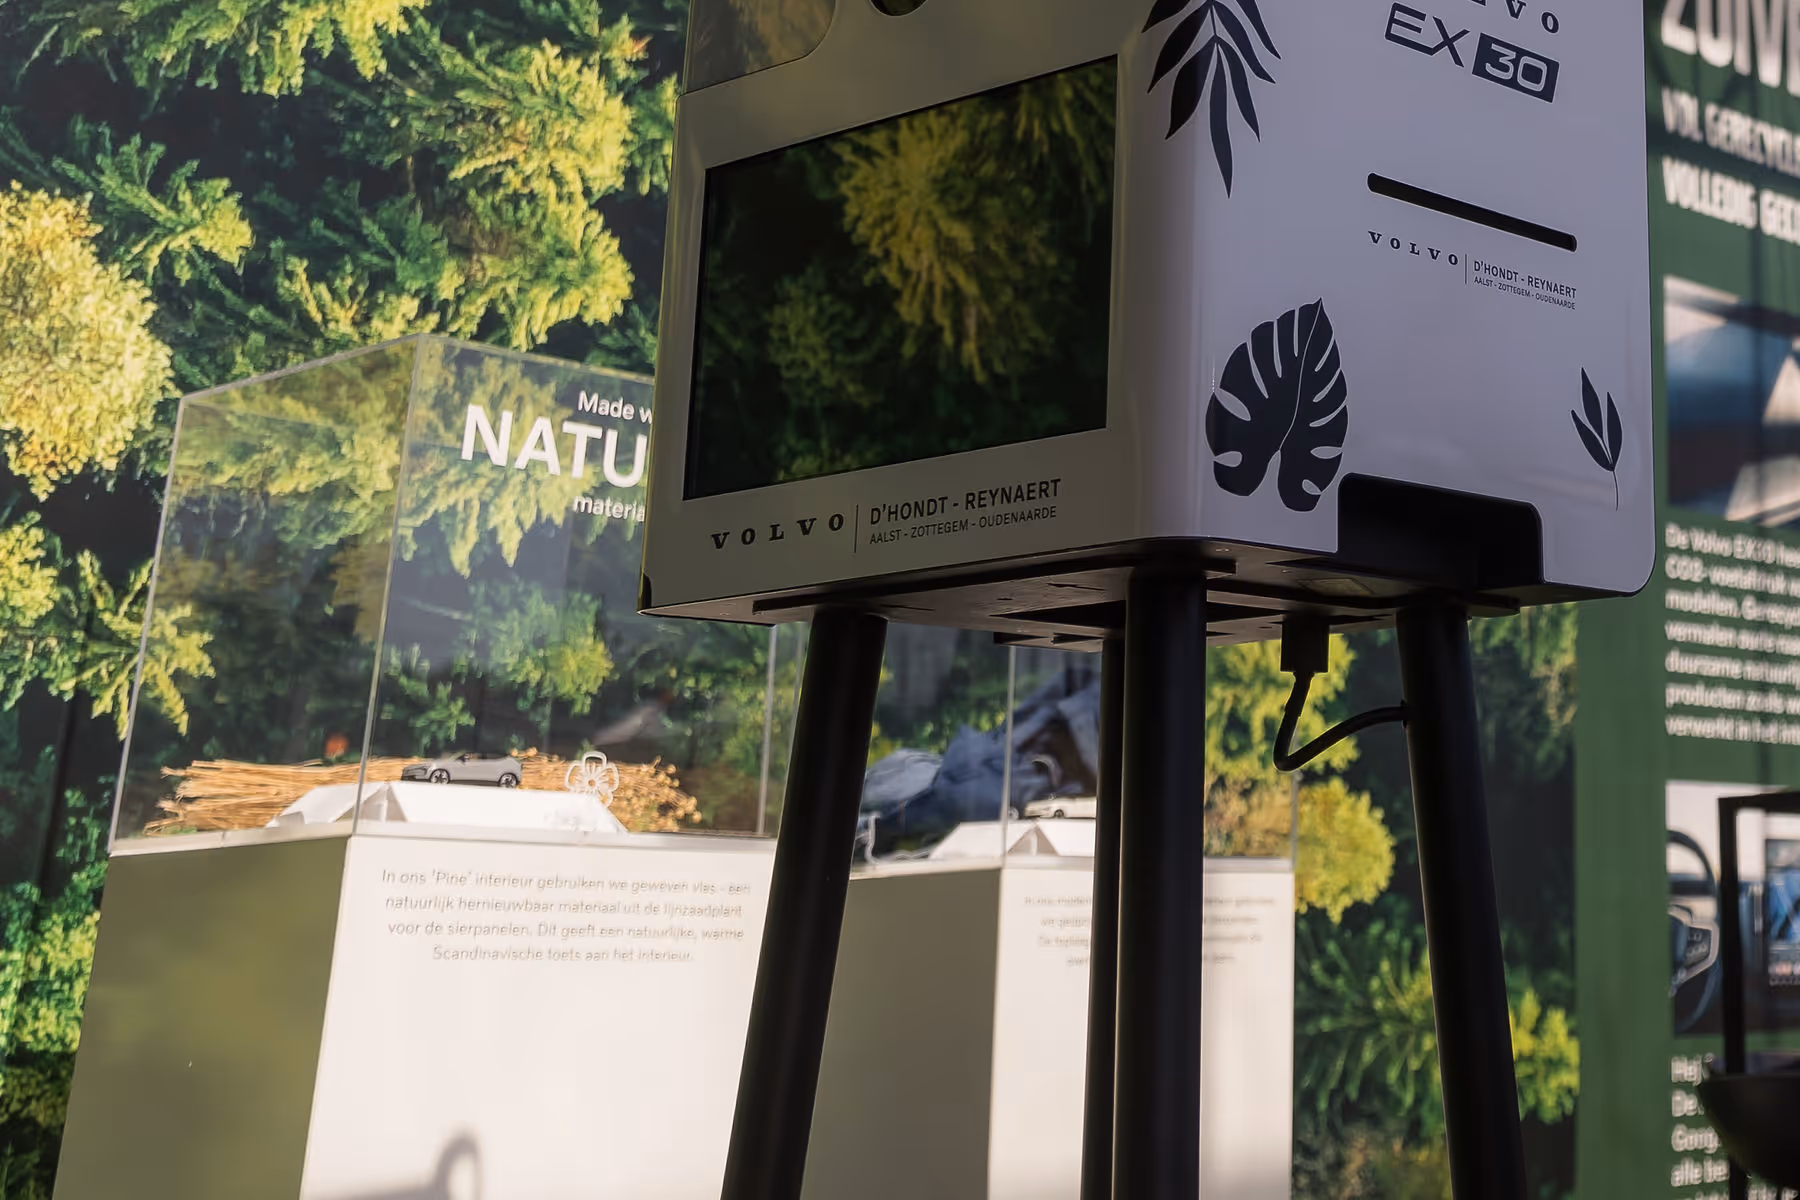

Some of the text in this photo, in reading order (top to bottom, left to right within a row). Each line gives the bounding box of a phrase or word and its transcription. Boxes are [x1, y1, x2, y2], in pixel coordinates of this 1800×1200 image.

[1662, 155, 1757, 229] VOLLEDIG
[1368, 231, 1458, 266] VOLVO
[1474, 260, 1519, 282] D'HONDT
[1527, 275, 1577, 299] REYNAERT
[1474, 276, 1493, 287] AALST
[1498, 282, 1531, 298] ZOTTEGEM
[1535, 292, 1576, 310] OUDENAARDE
[578, 390, 634, 420] Made
[871, 497, 948, 525] D'HONDT
[966, 478, 1061, 510] REYNAERT
[711, 513, 844, 550] VOLVO
[870, 530, 901, 544] AALST
[911, 519, 969, 539] ZOTTEGEM
[979, 506, 1056, 528] OUDENAARDE
[382, 869, 395, 883] In
[400, 872, 426, 884] ons
[476, 873, 533, 888] interieur
[537, 874, 604, 891] gebruiken
[609, 881, 628, 891] we
[632, 882, 688, 895] geweven
[385, 895, 453, 913] natuurlijk
[458, 897, 554, 913] hernieuwbaar
[388, 922, 420, 936] voor
[425, 920, 442, 936] de
[538, 922, 557, 937] Dit
[432, 944, 543, 961] Scandinavische
